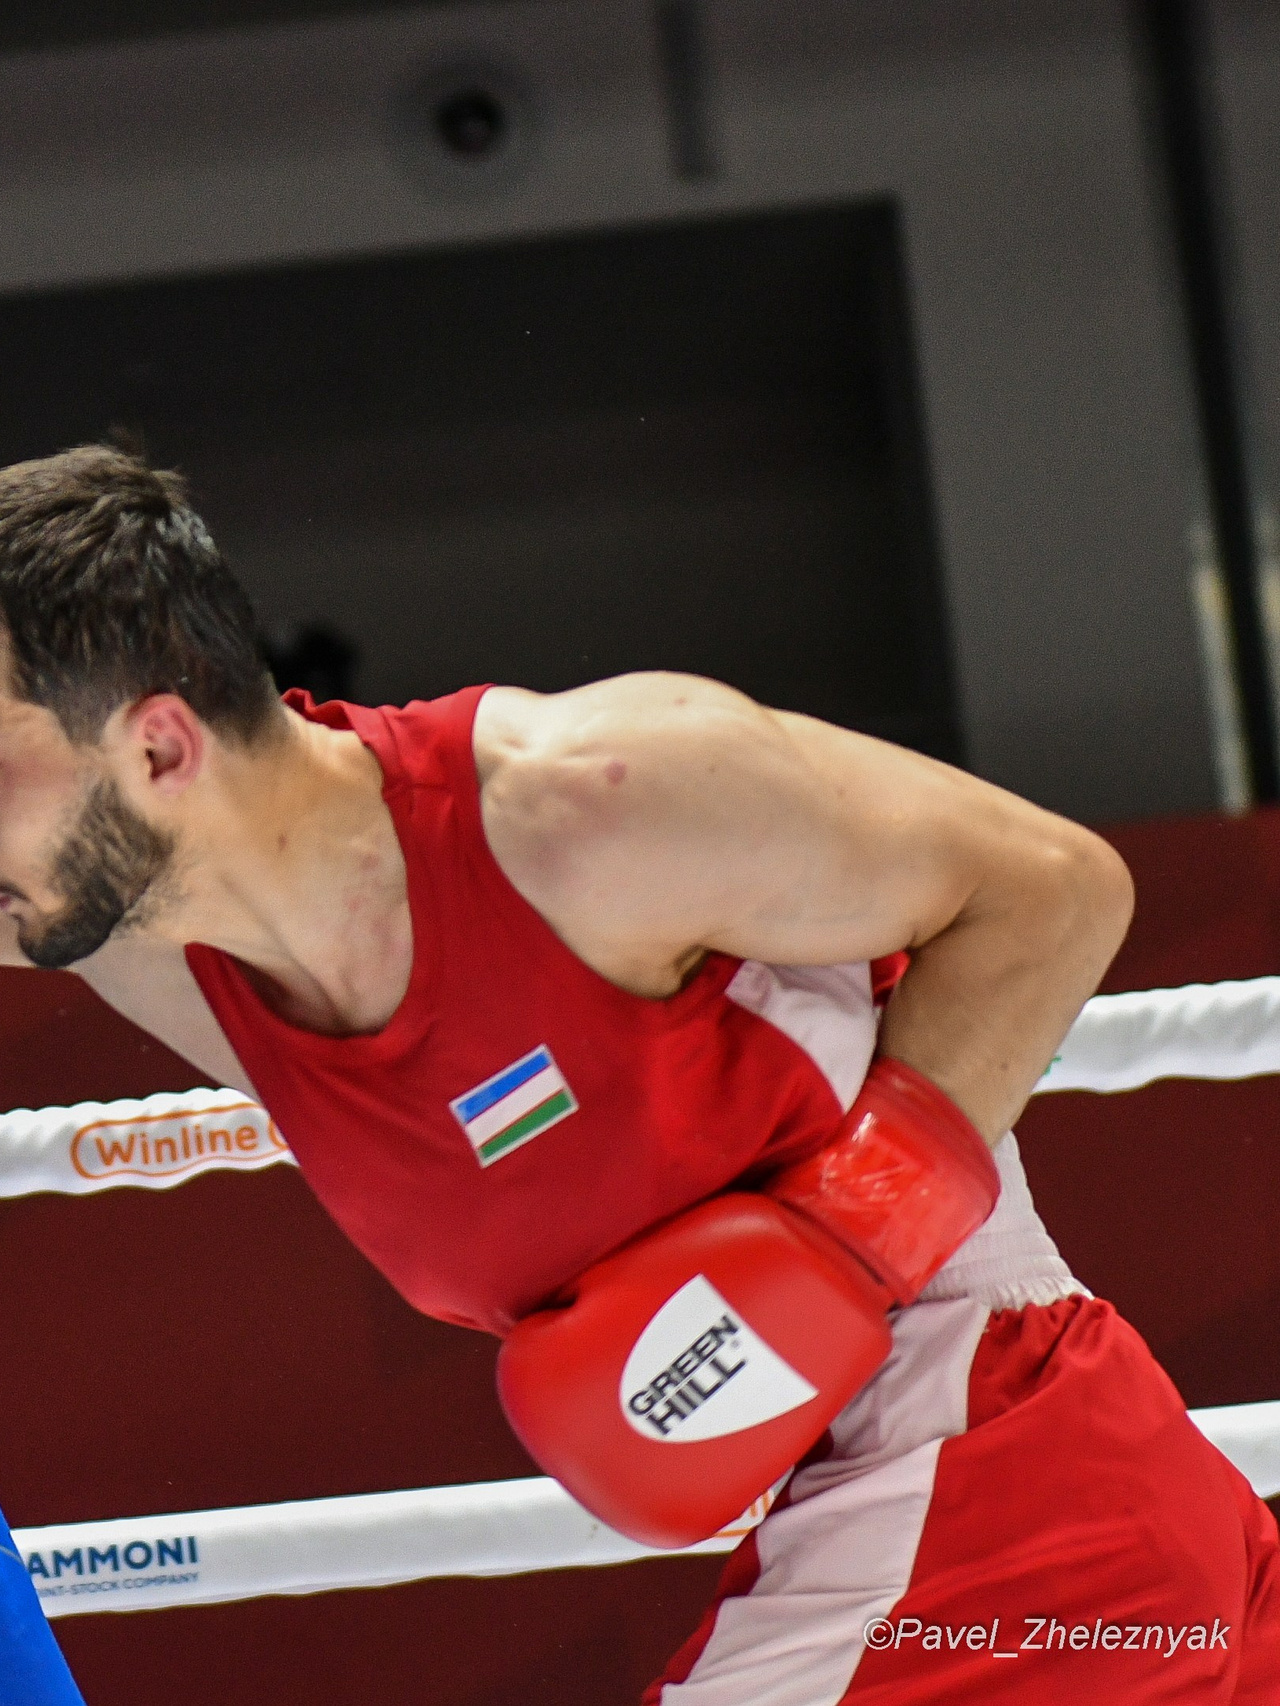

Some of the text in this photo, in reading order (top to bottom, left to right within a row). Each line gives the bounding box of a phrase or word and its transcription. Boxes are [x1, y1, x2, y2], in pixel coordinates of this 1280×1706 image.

[95, 1124, 260, 1166] Winline
[628, 1313, 740, 1416] GREEN
[645, 1357, 749, 1436] HILL
[27, 1535, 199, 1579] AMMONI
[123, 1571, 199, 1590] COMPANY
